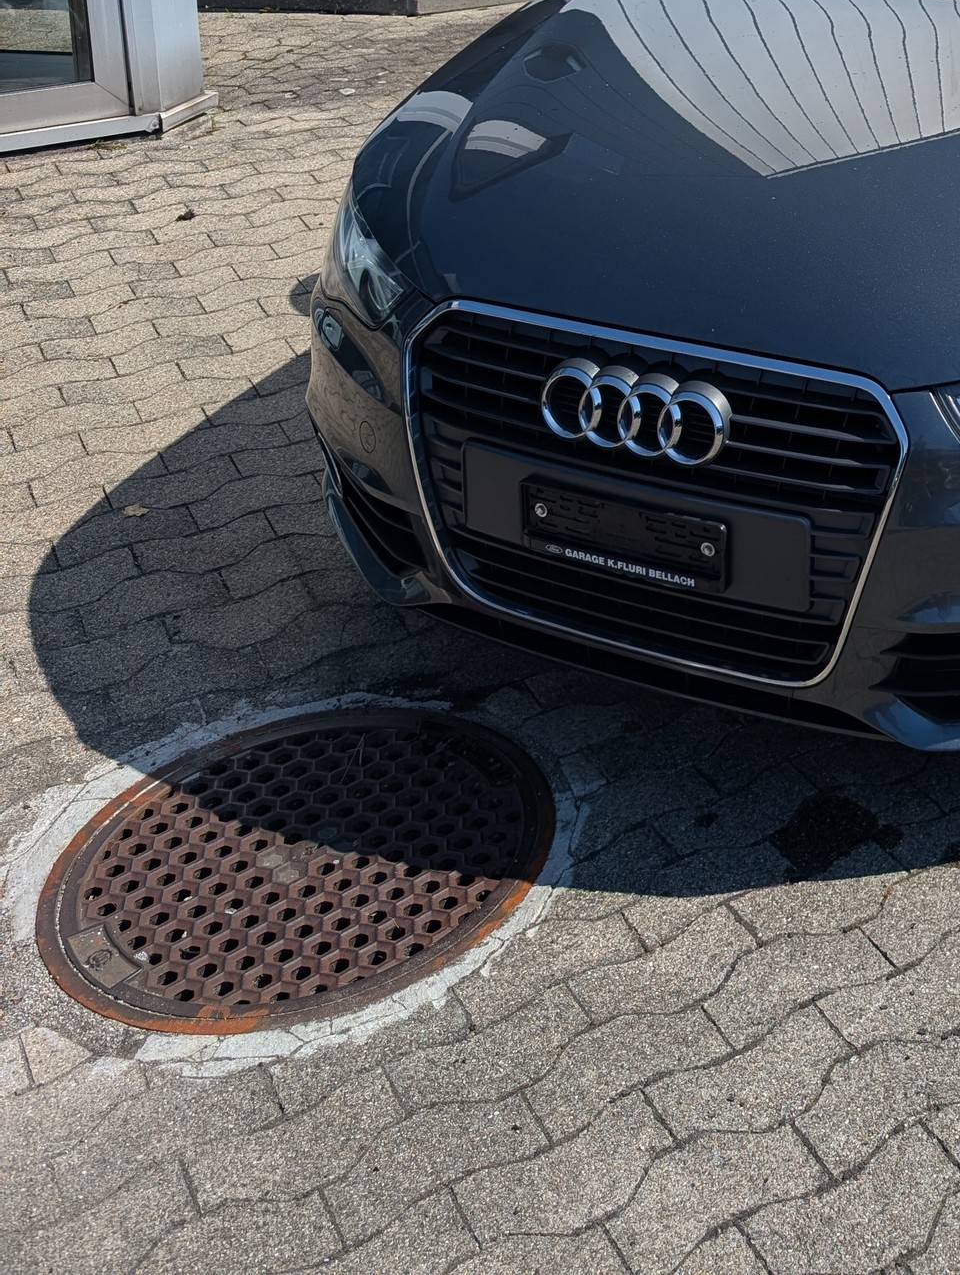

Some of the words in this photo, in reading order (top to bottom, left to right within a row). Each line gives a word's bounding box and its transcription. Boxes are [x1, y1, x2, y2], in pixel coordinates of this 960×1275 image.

[564, 548, 605, 565] GARAGE
[607, 558, 646, 576] K.FLURI
[648, 568, 695, 587] BELLACH
